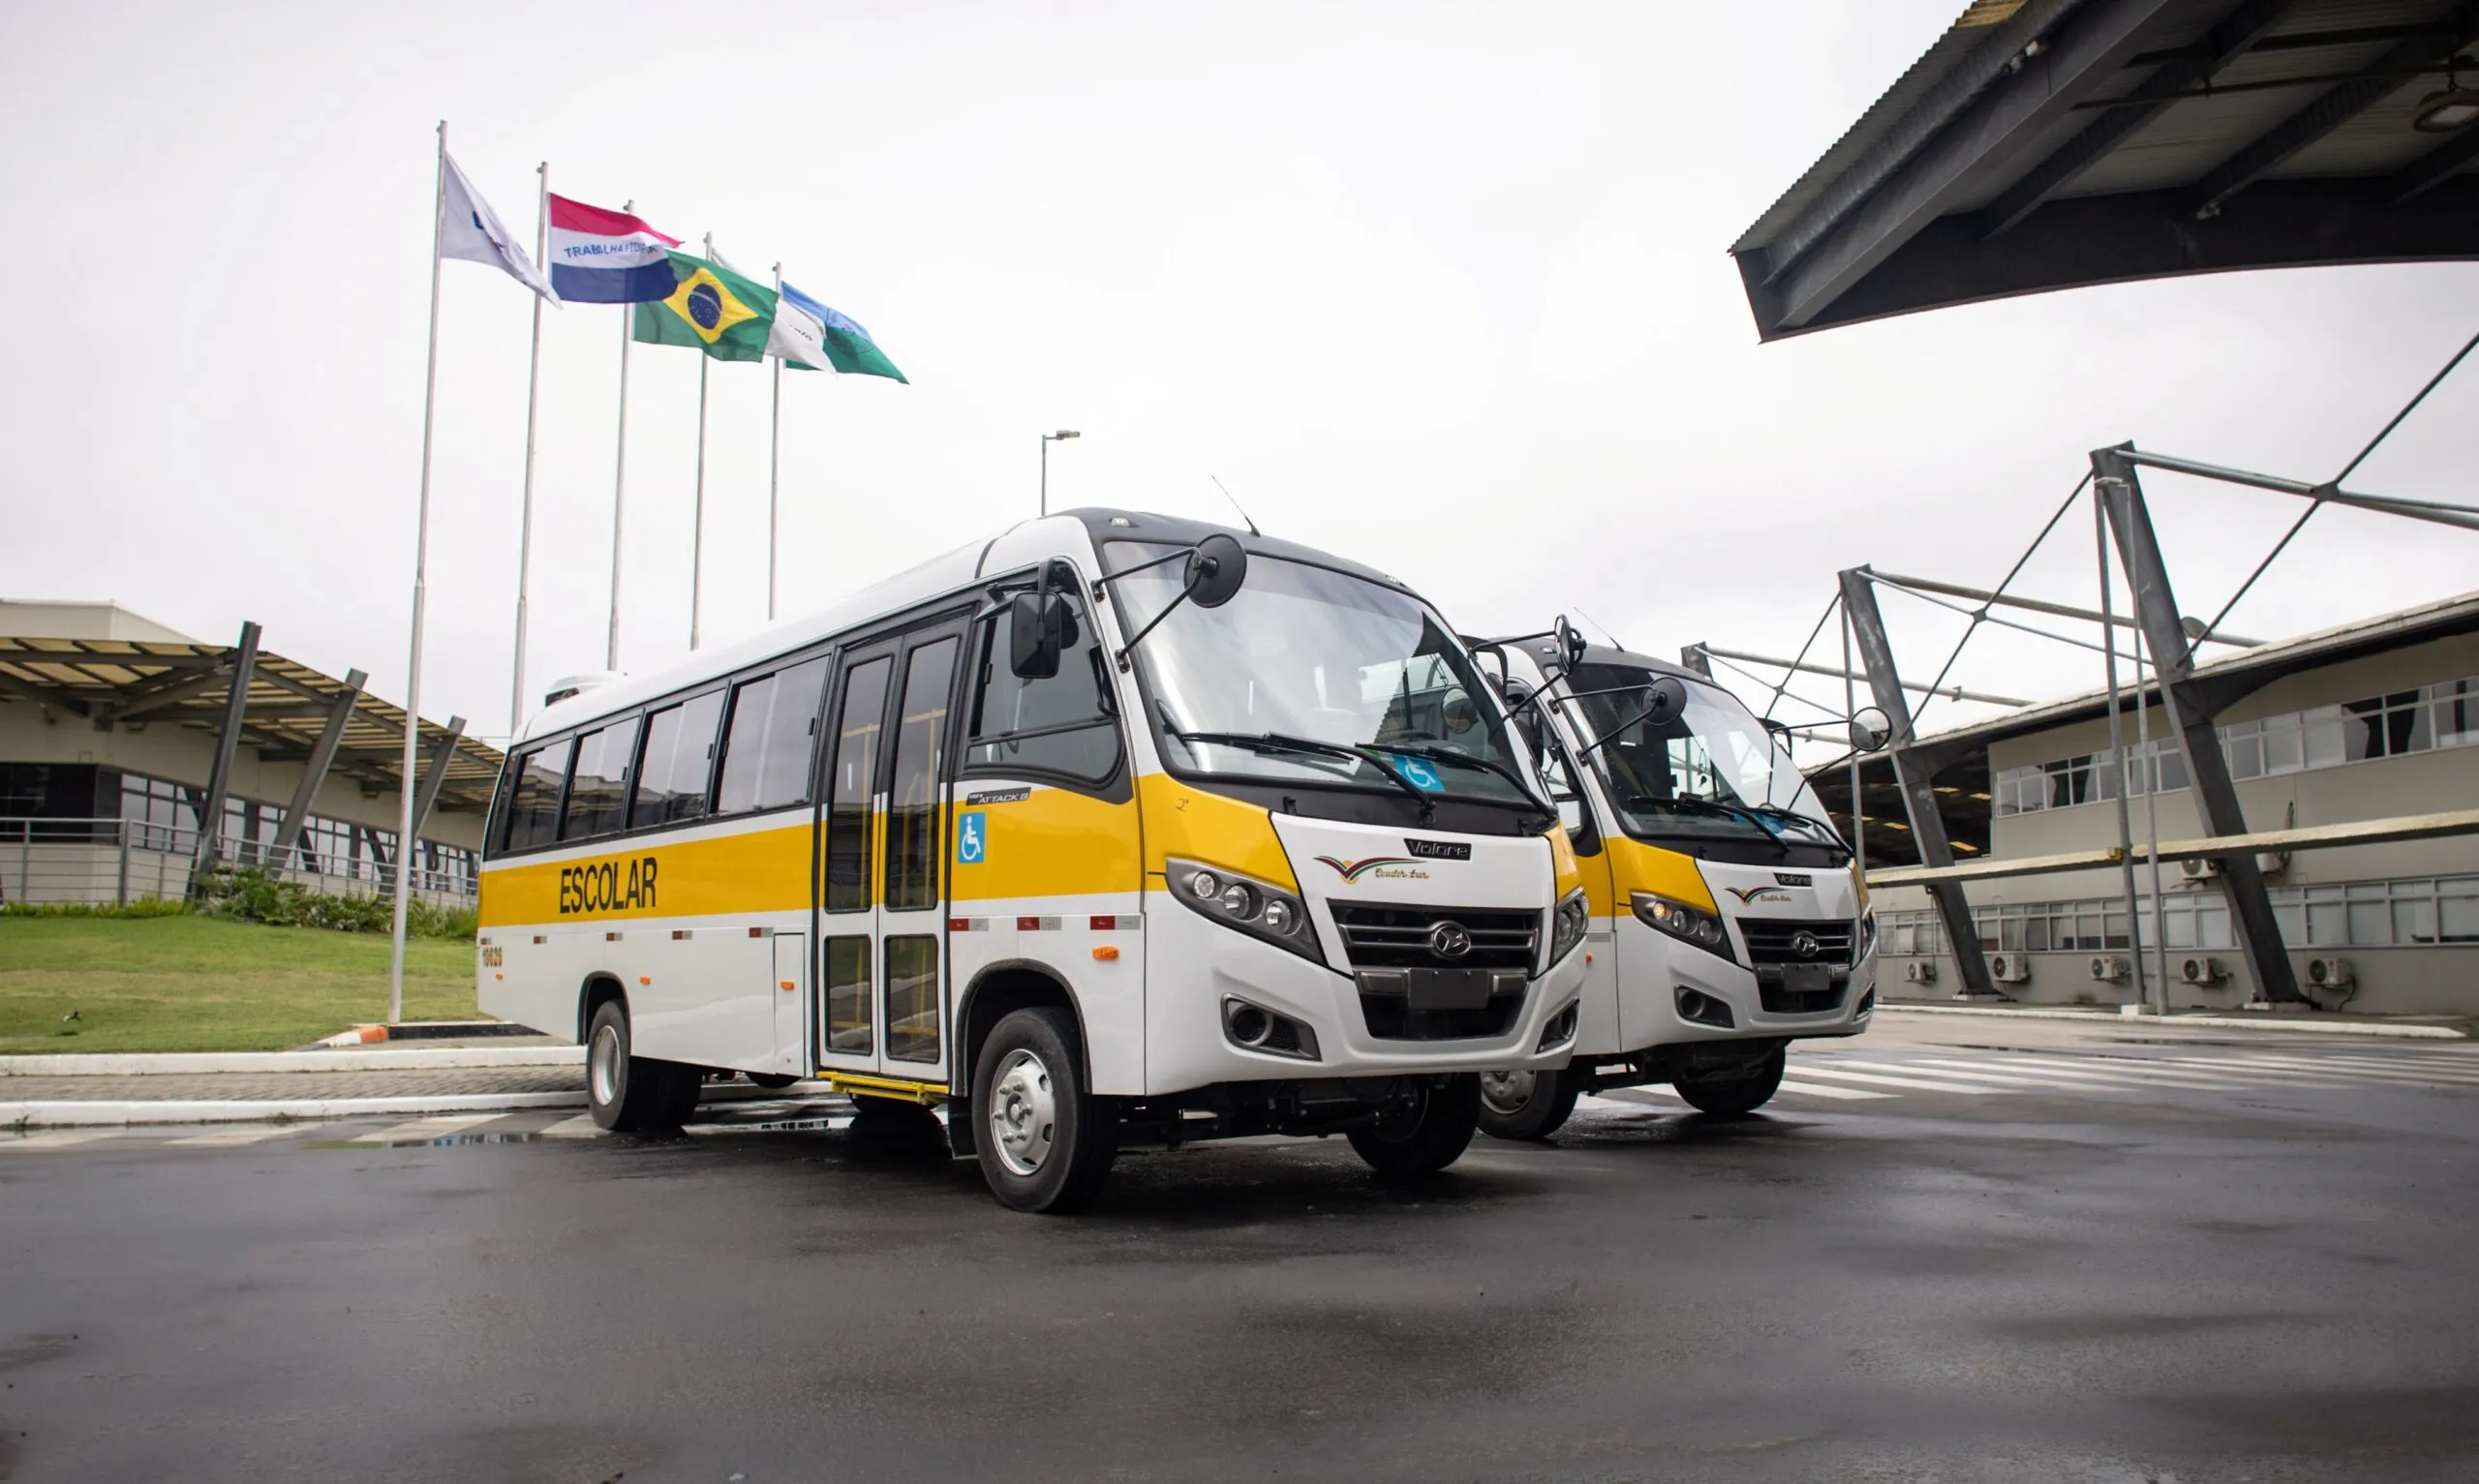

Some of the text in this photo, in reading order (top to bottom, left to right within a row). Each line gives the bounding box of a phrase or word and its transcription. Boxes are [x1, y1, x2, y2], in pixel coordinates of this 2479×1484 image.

[978, 794, 1018, 803] ATTACK
[1410, 839, 1468, 857] Volare
[560, 857, 658, 914] ESCOLAR
